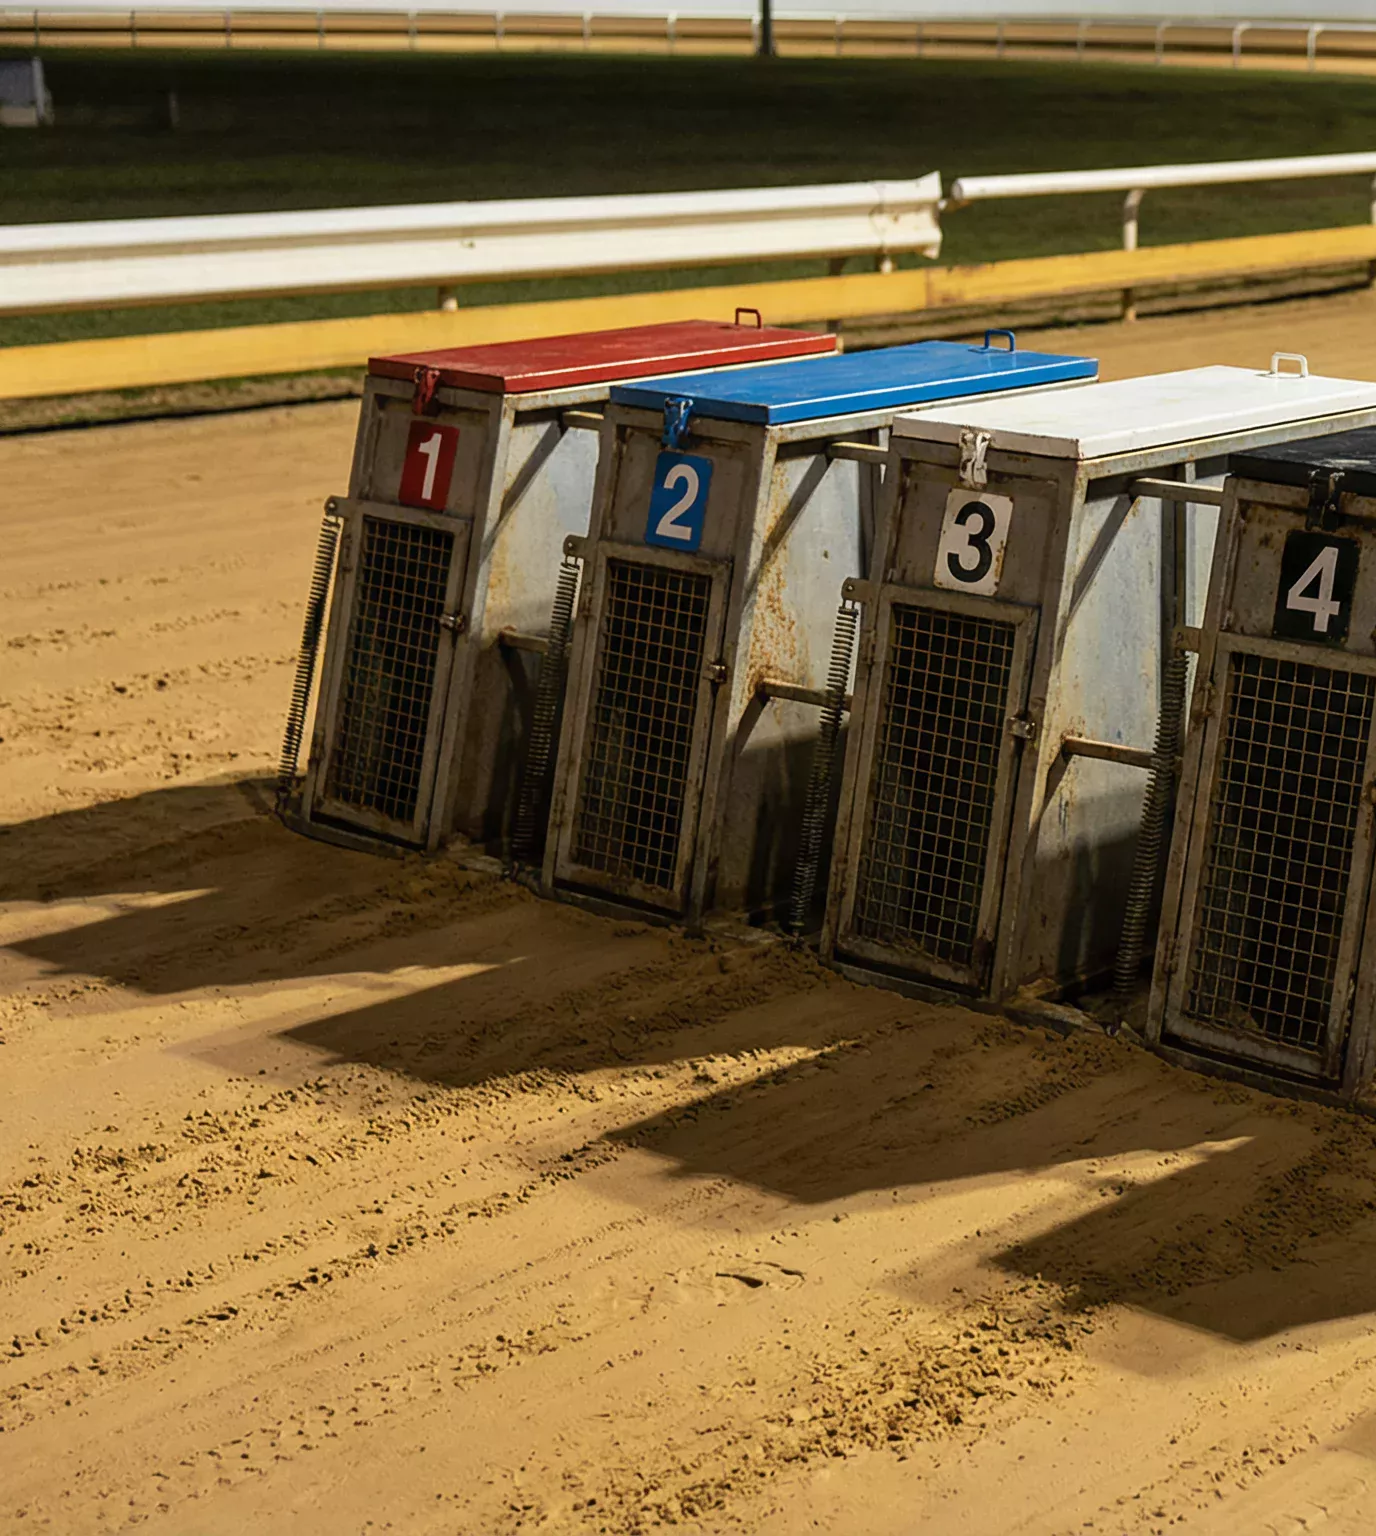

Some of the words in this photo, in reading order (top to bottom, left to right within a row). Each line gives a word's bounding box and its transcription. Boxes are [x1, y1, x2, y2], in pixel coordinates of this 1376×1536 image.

[418, 432, 442, 500] 1
[655, 464, 699, 541] 2
[947, 500, 996, 583] 3
[1286, 546, 1340, 632] 4
